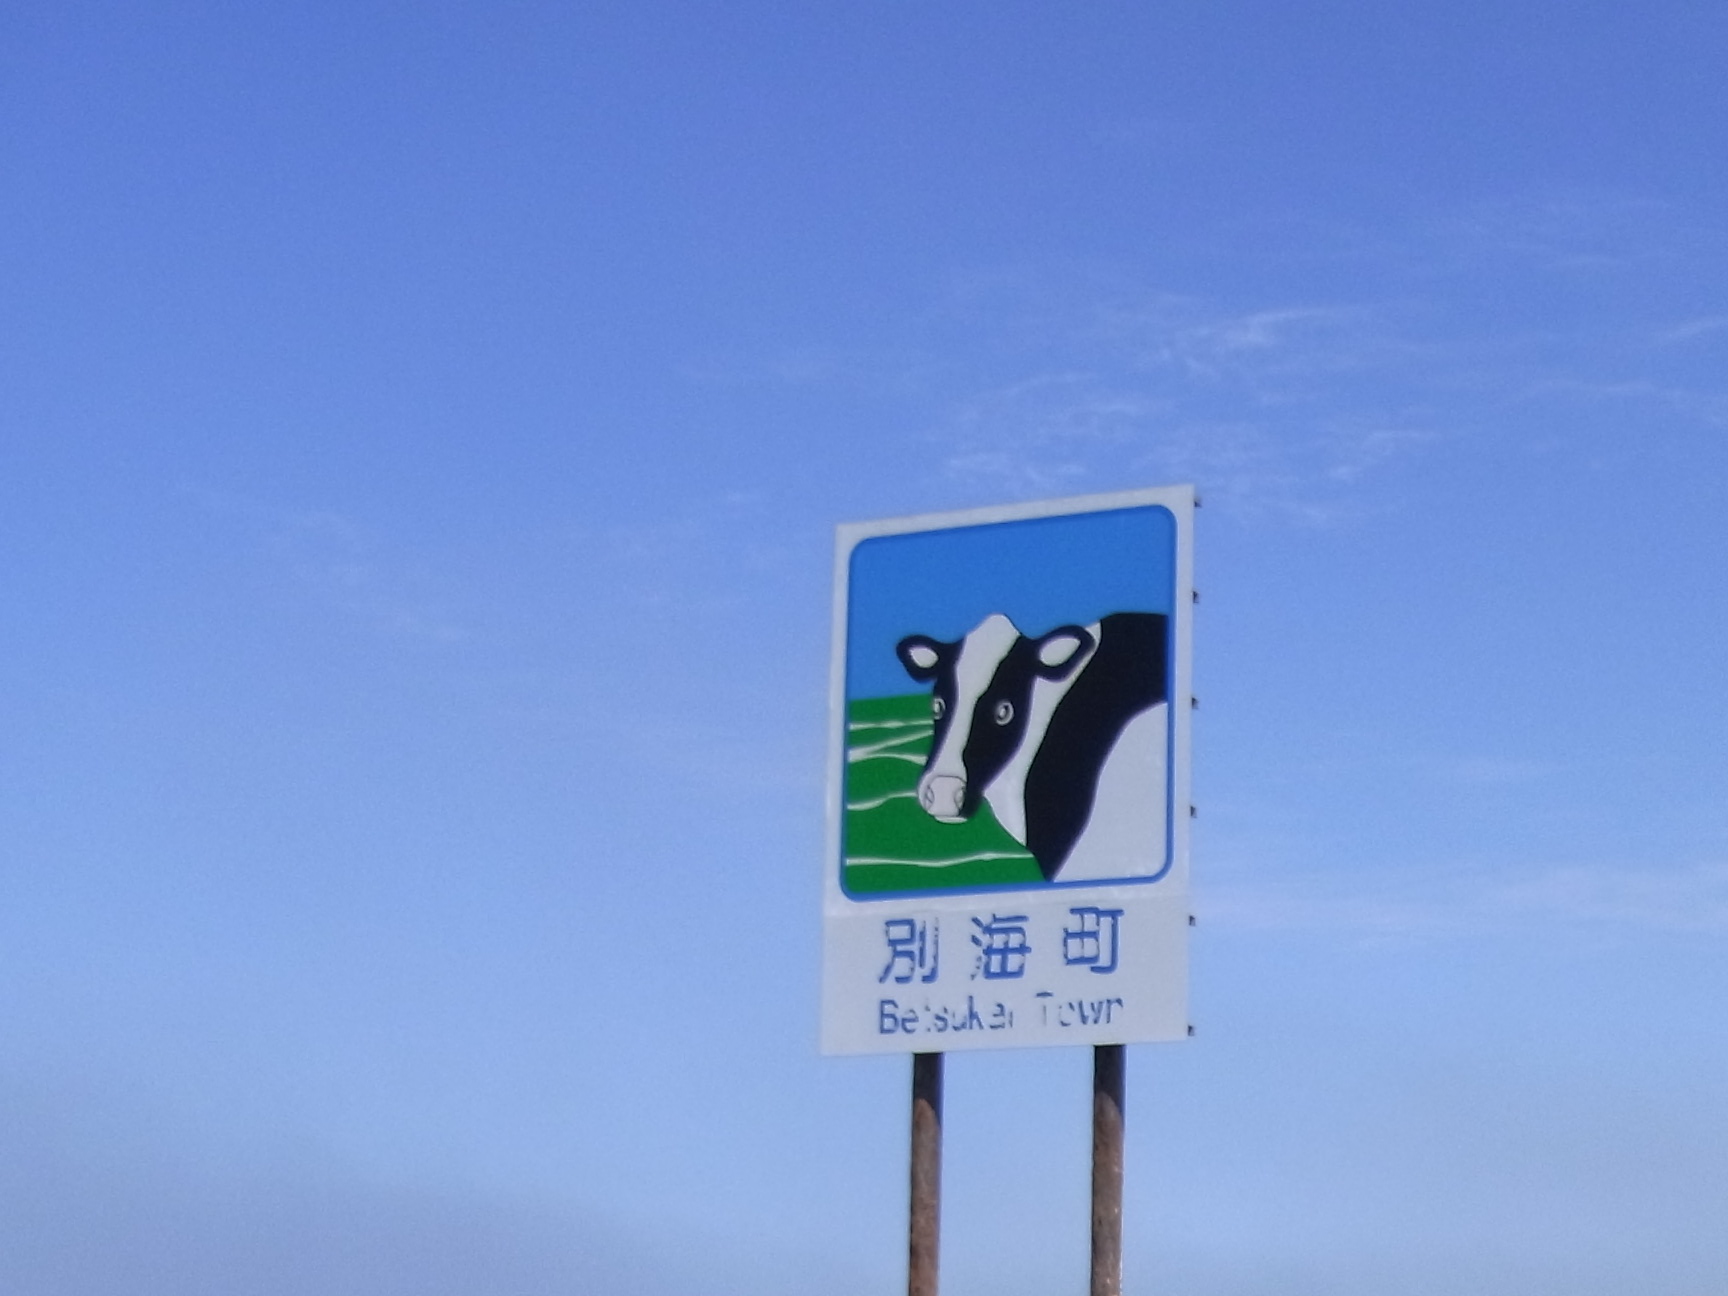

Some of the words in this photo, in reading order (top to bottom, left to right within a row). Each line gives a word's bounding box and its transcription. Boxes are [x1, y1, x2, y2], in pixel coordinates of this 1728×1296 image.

[879, 907, 1125, 983] 別海町
[879, 995, 1013, 1034] Besukai
